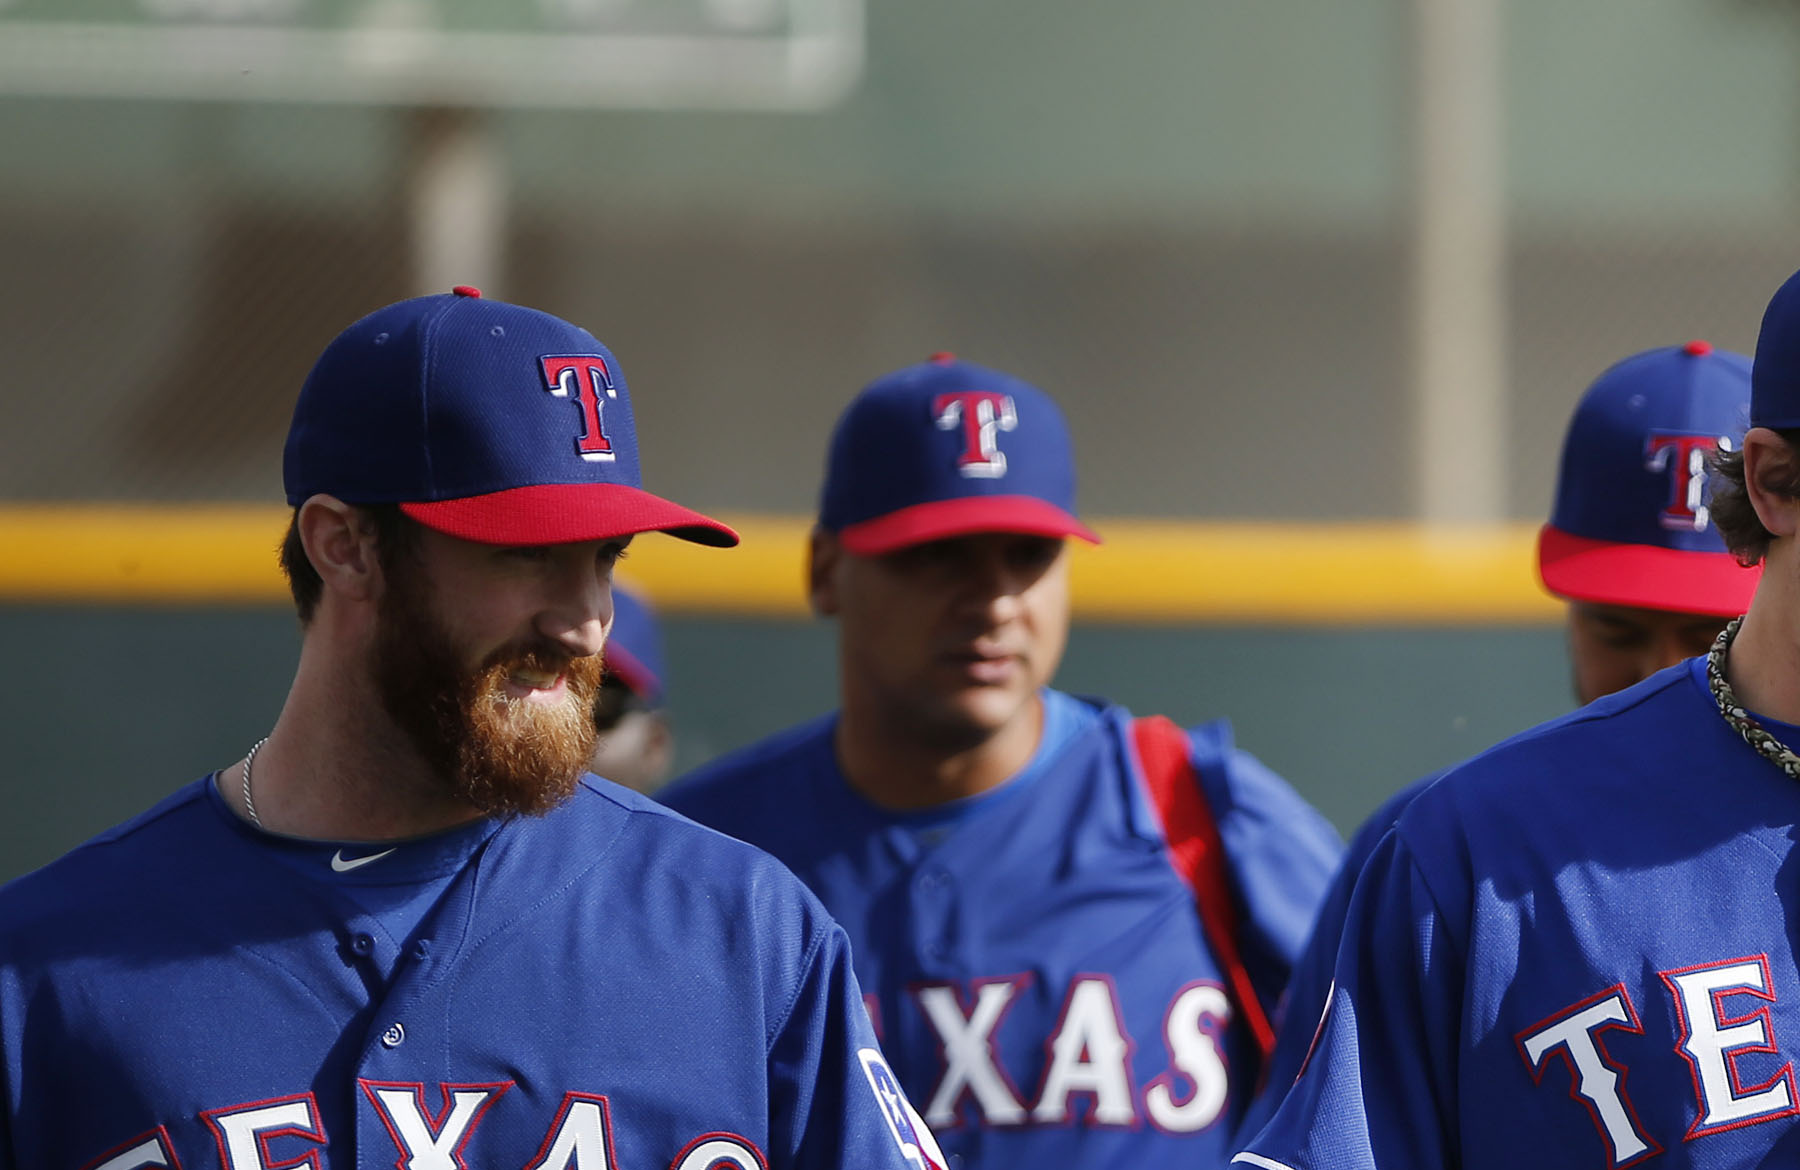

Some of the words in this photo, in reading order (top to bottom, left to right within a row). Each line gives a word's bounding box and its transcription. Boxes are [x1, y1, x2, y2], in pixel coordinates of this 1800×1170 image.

[538, 353, 617, 462] T
[932, 390, 1019, 479] T
[1644, 429, 1732, 532] T
[864, 971, 1241, 1138] XAS
